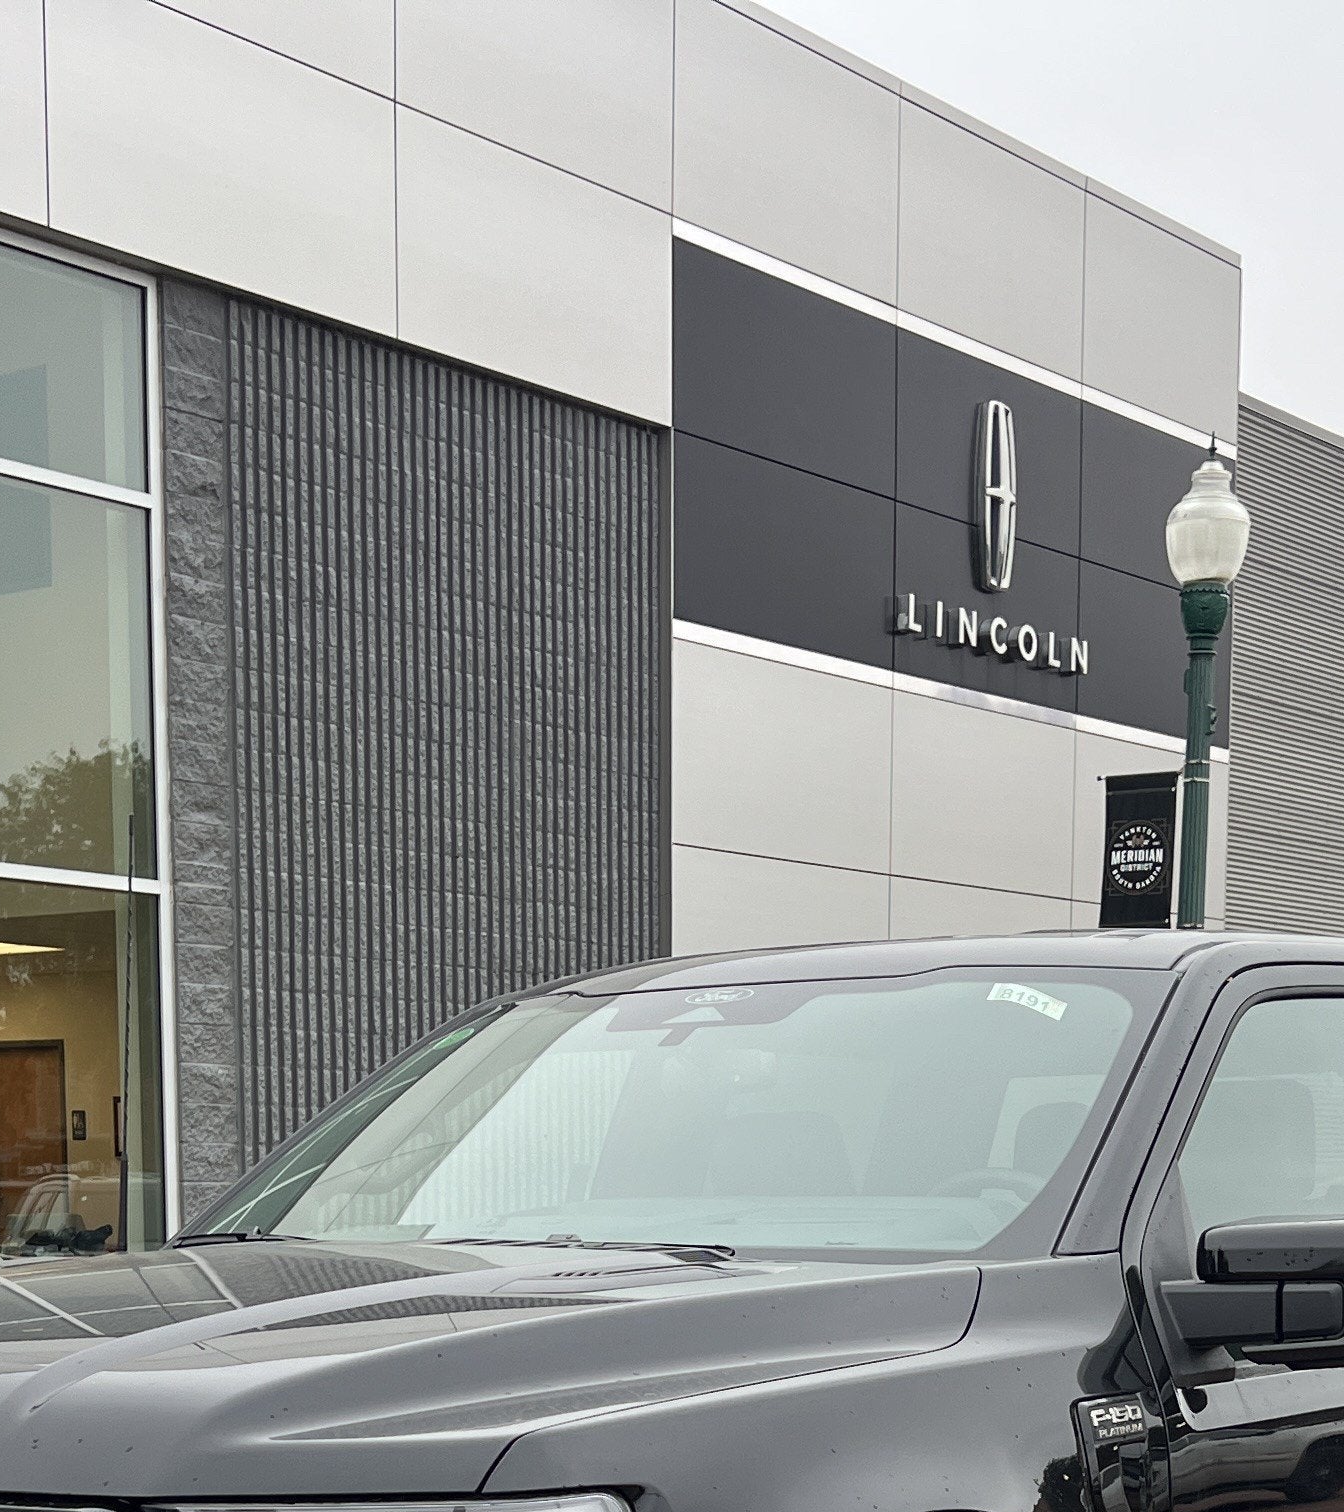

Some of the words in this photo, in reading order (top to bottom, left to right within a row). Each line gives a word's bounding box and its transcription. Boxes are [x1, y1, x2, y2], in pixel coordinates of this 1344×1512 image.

[896, 593, 1089, 675] LINCOLN
[1119, 826, 1156, 841] YANKTON
[1110, 847, 1164, 866] MERIDIAN
[1119, 862, 1154, 873] DISTRICT
[999, 987, 1050, 1013] 8191
[1090, 1404, 1143, 1427] F-150
